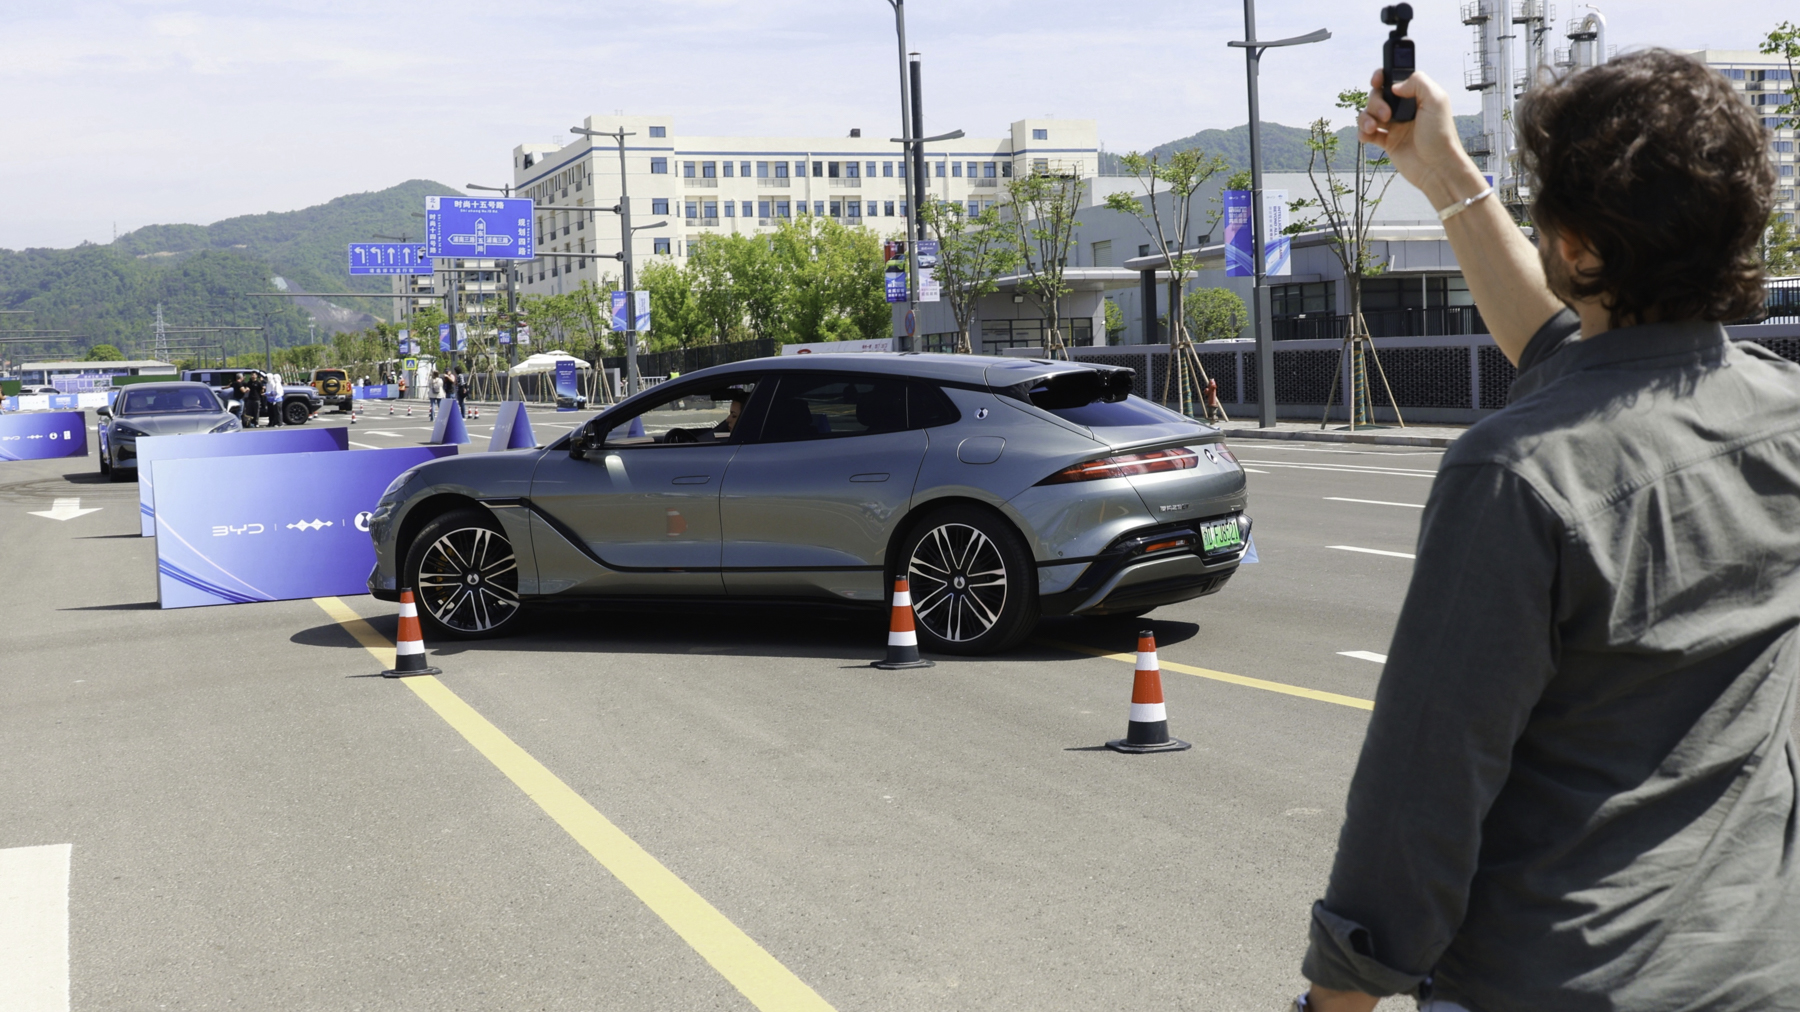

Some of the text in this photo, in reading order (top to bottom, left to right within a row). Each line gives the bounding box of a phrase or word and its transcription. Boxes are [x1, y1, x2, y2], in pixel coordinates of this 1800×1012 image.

[454, 200, 504, 209] 时尚十五号路
[518, 218, 526, 256] 规划四路
[212, 523, 264, 536] BYD
